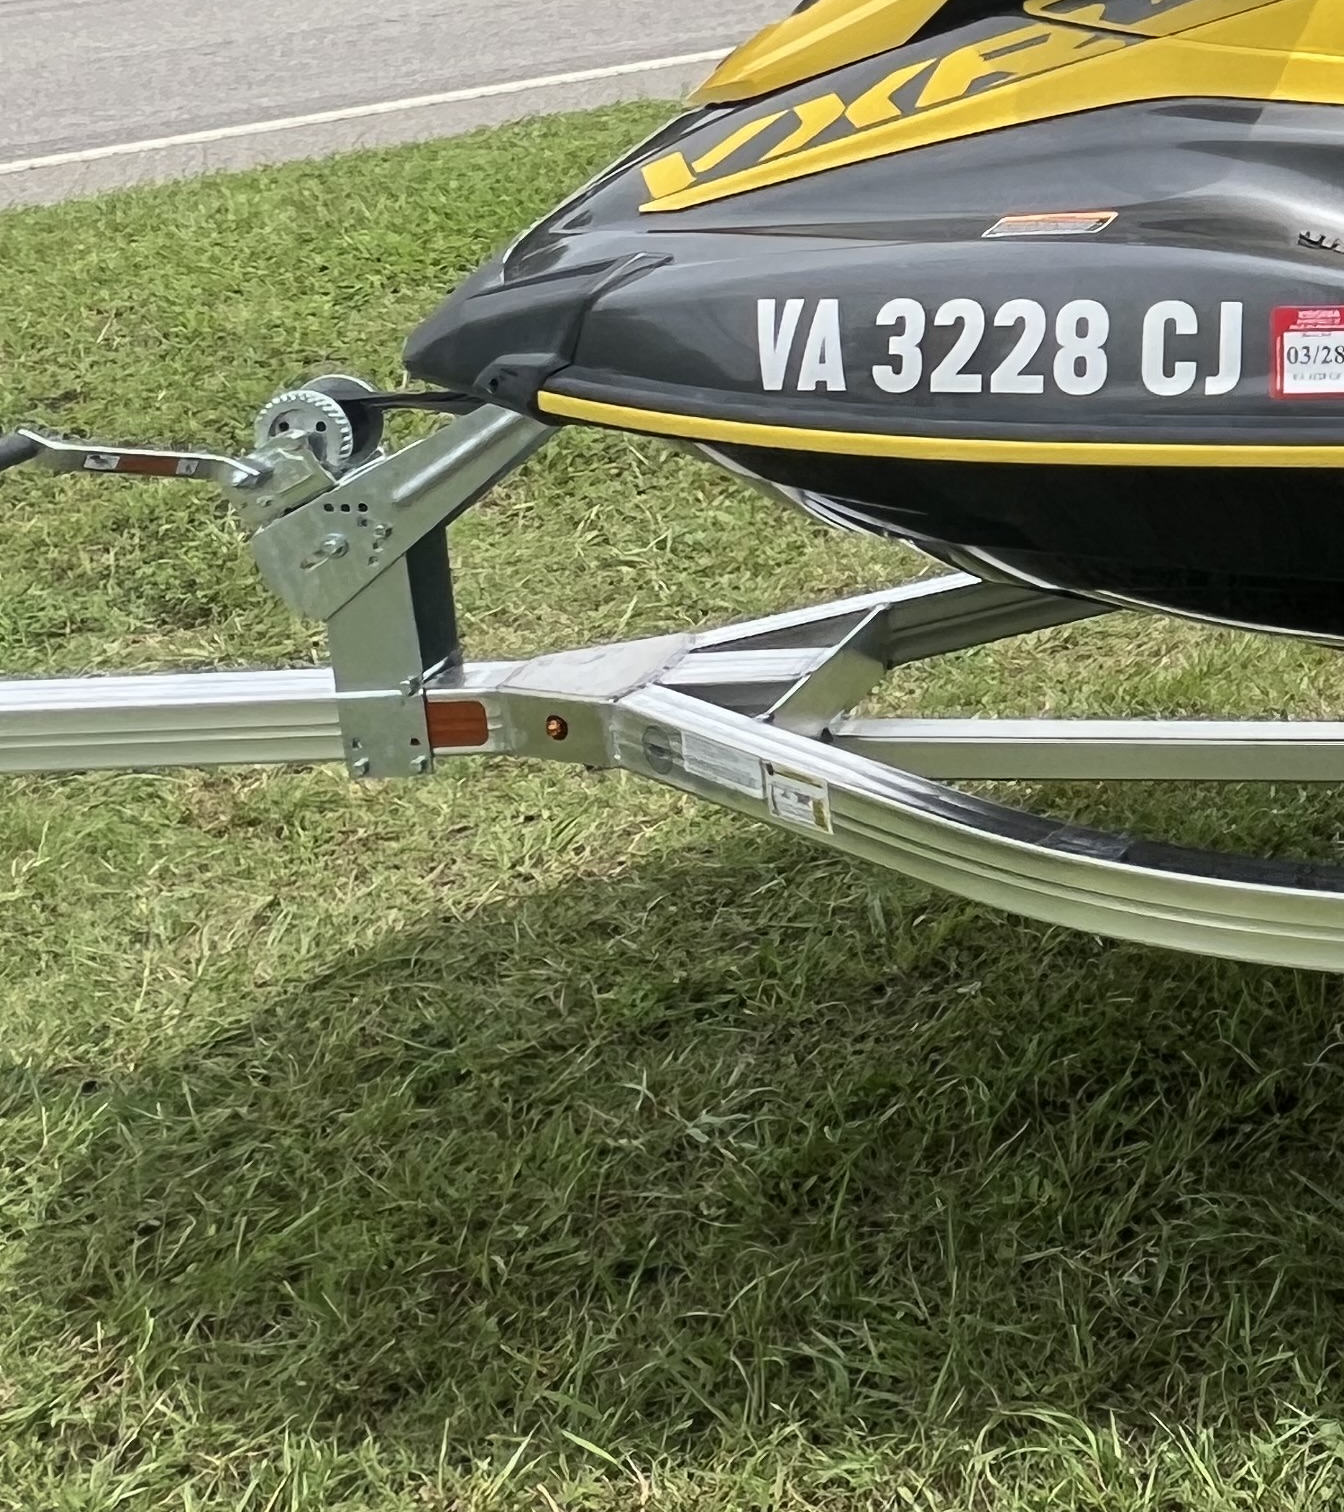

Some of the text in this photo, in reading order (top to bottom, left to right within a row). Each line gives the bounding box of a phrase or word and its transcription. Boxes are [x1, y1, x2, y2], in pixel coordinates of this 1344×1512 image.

[757, 297, 1243, 396] VA 3228 CJ
